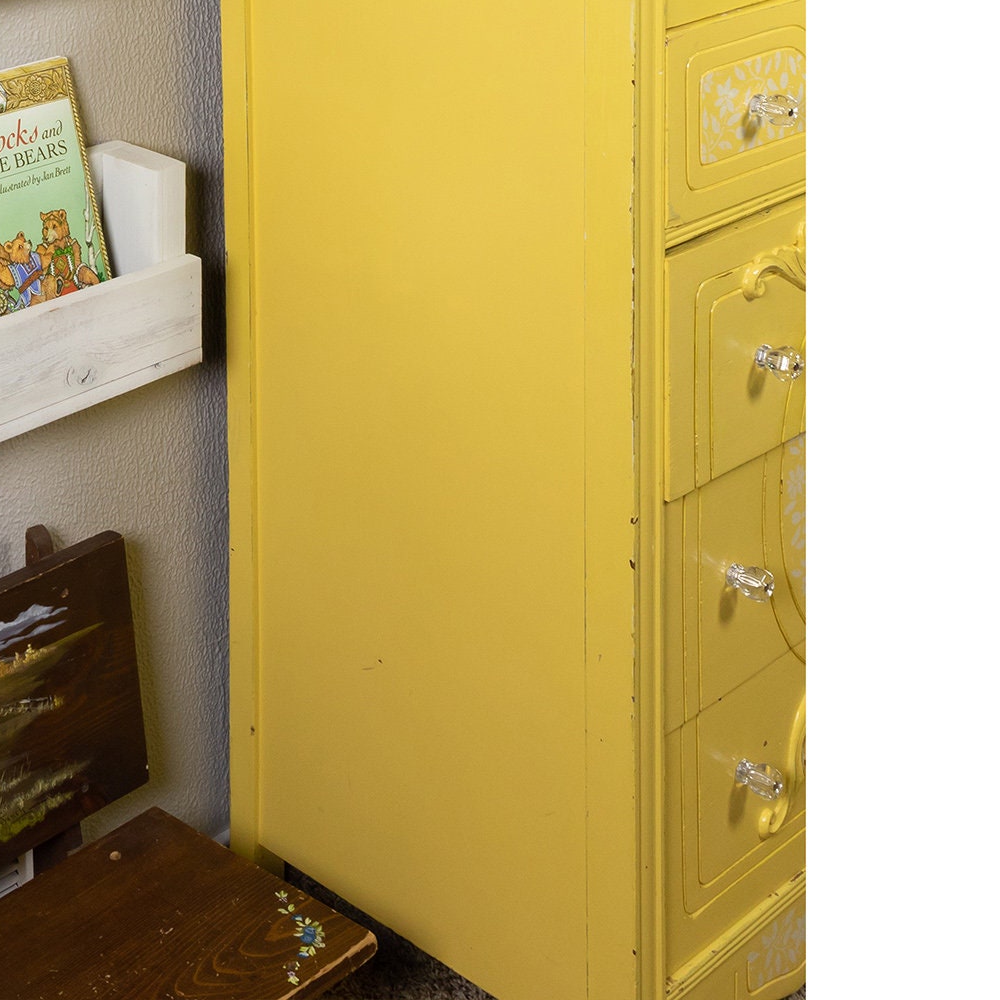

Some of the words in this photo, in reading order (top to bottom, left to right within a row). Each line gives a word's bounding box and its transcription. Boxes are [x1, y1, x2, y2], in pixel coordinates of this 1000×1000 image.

[41, 120, 63, 141] and
[15, 140, 68, 169] BEARS
[31, 175, 42, 191] by
[40, 170, 55, 185] Jan
[54, 166, 71, 179] Brett
